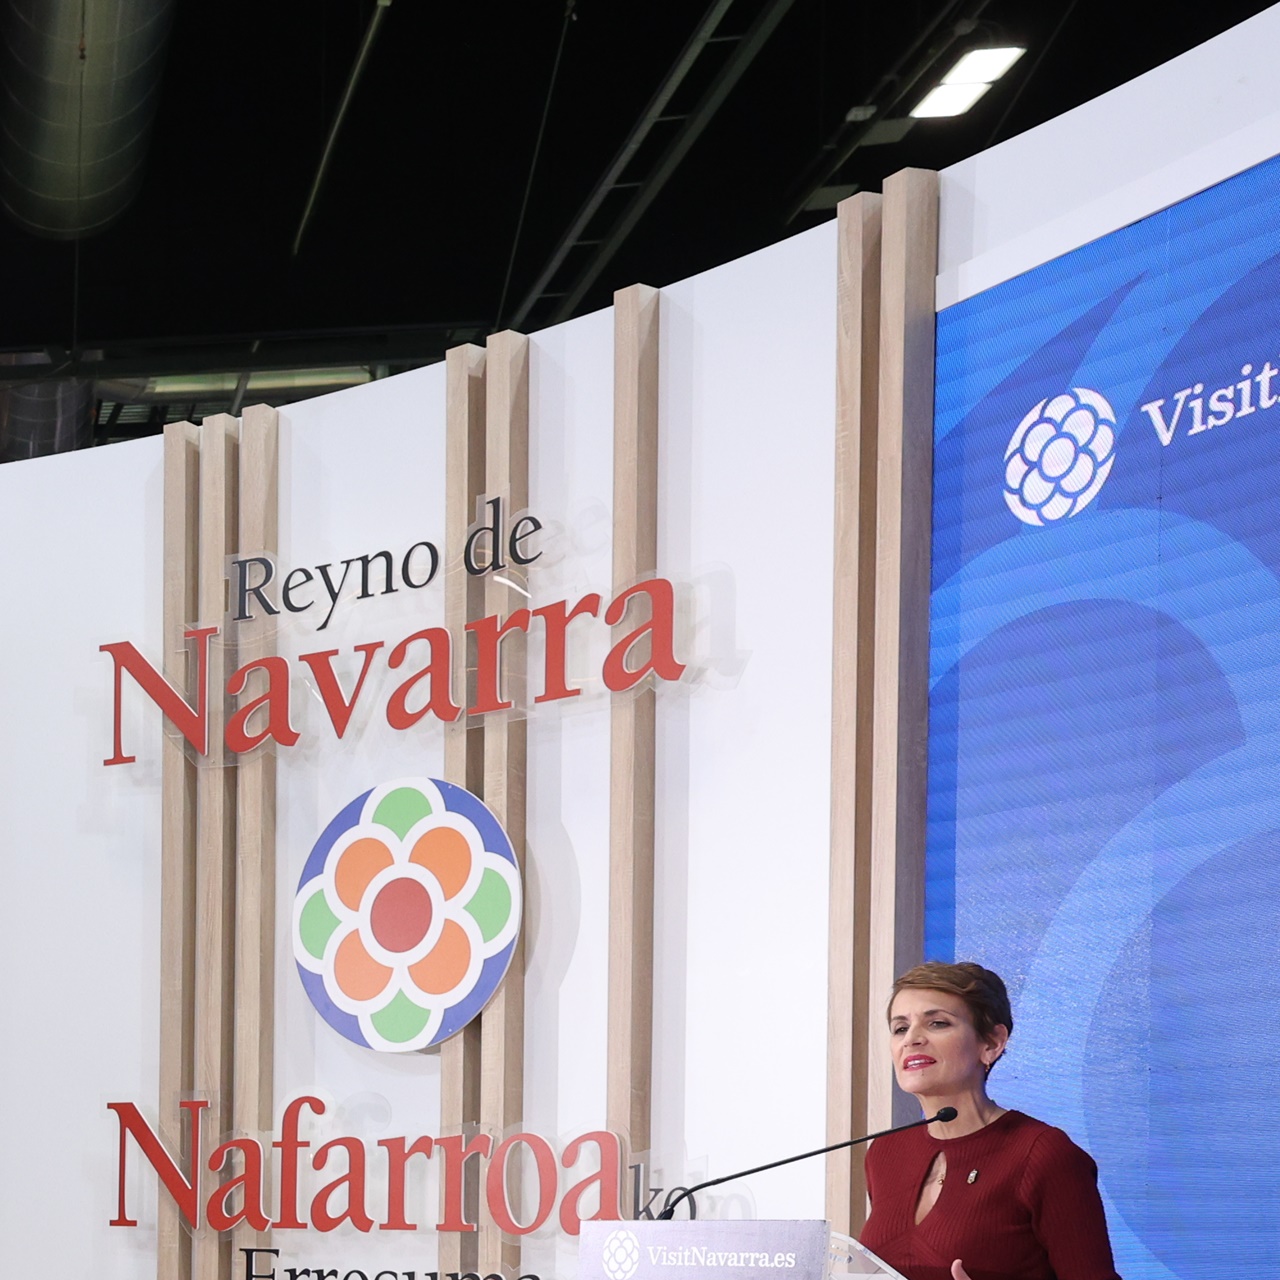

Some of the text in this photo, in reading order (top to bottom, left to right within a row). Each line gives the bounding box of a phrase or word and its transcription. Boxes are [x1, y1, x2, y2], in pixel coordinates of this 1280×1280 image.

[1141, 361, 1280, 446] Visit
[233, 497, 542, 631] Reyno de
[99, 577, 687, 766] Navarra
[646, 1246, 796, 1269] VisitNavarra.es
